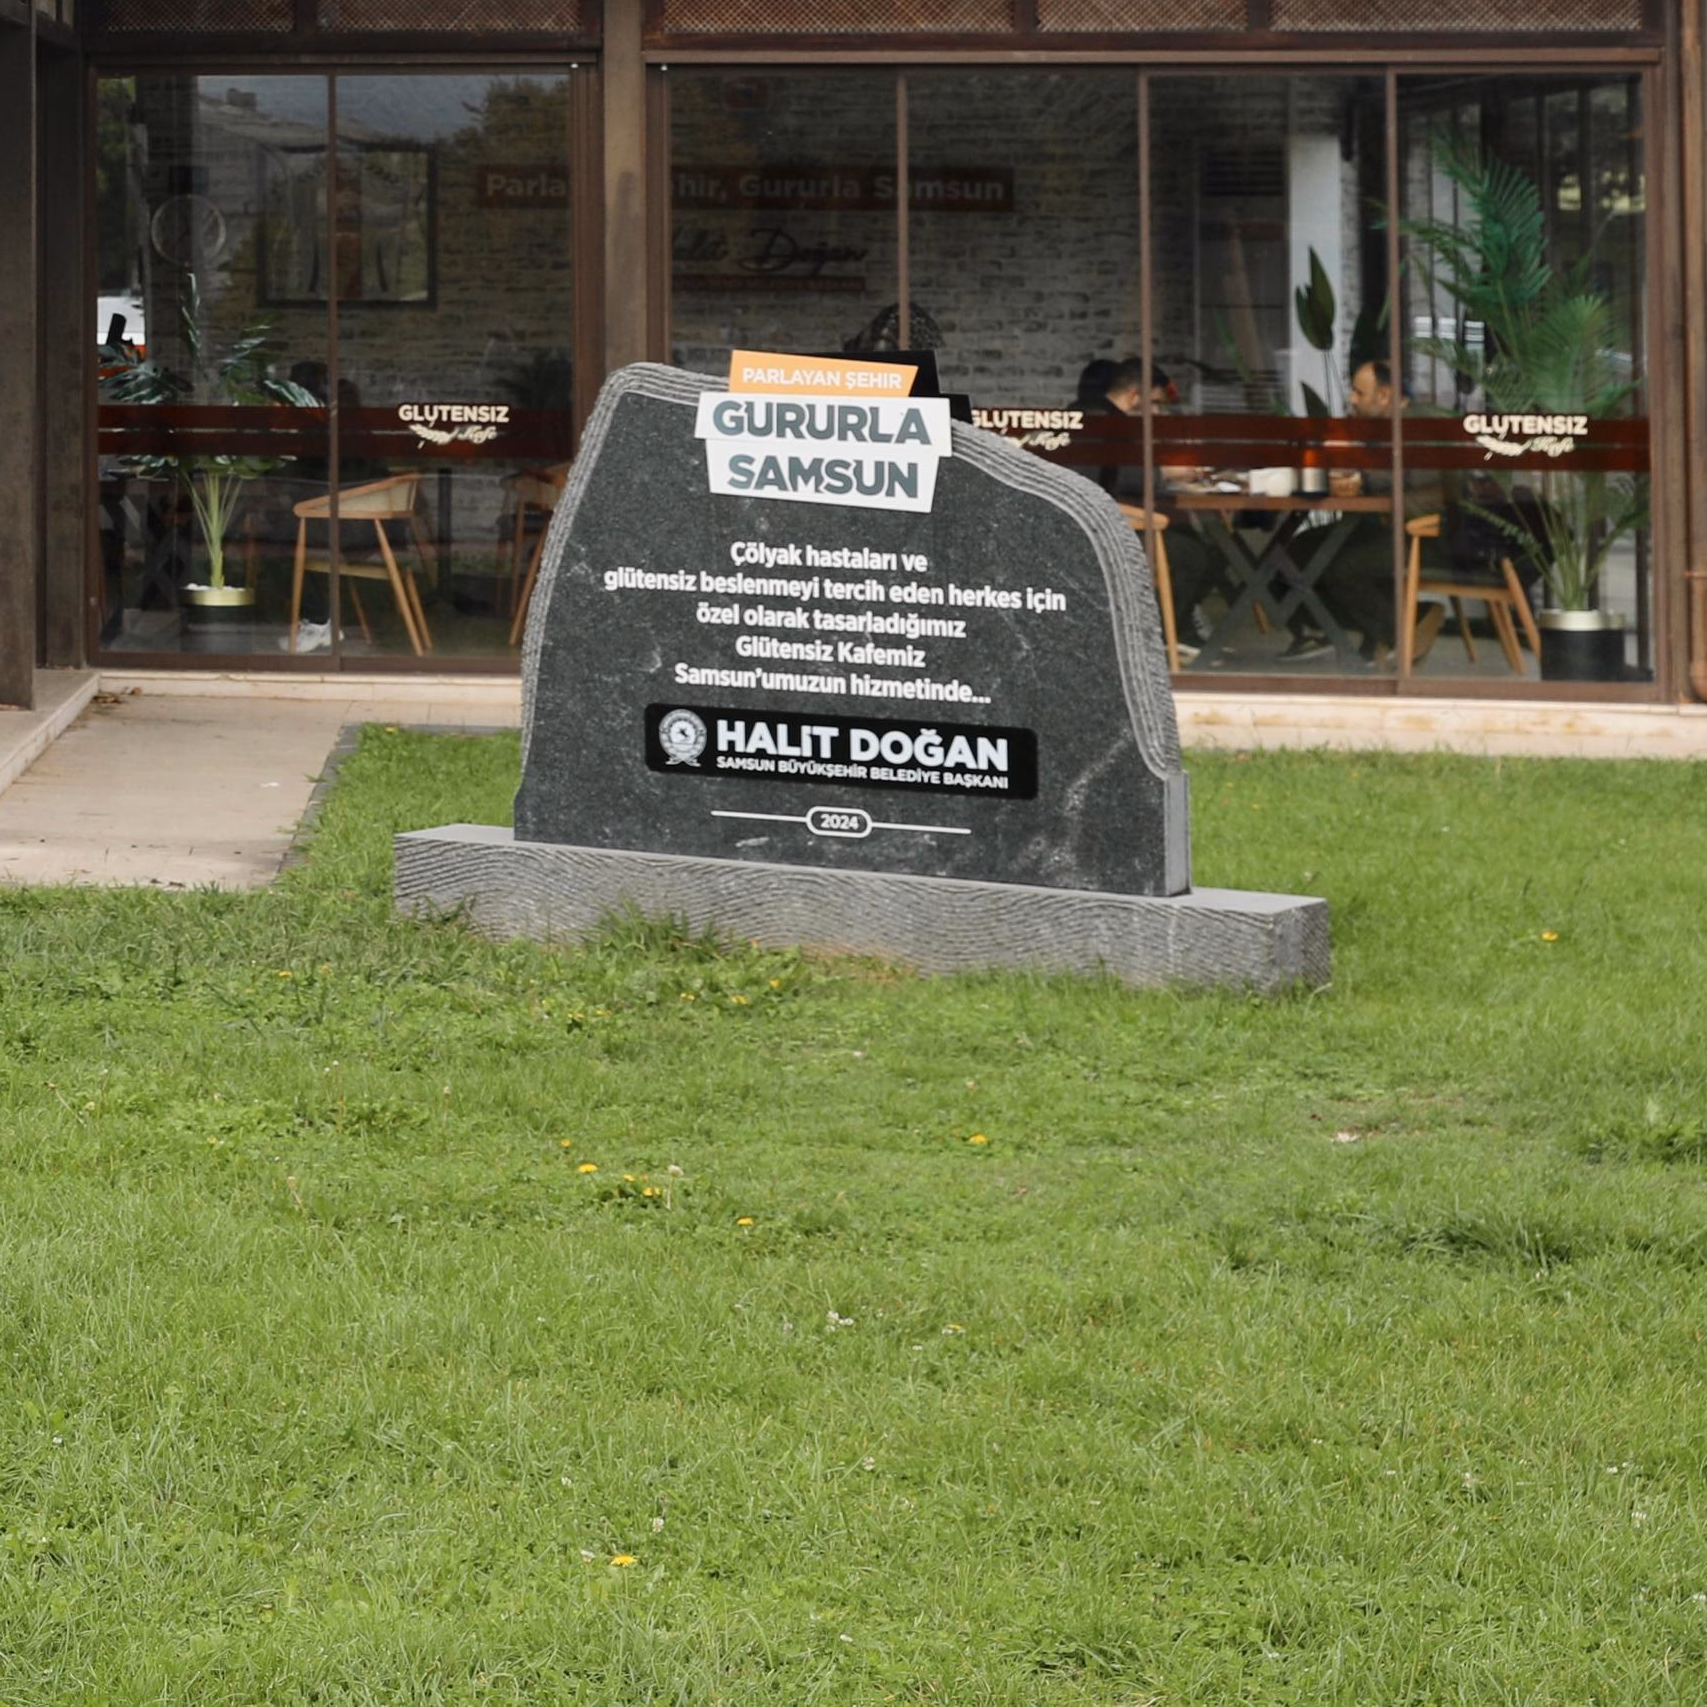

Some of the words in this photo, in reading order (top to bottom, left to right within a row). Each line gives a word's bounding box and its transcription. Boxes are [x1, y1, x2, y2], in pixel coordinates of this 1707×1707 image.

[873, 175, 1005, 200] Smsun
[741, 367, 841, 387] PARLAYAN
[712, 400, 932, 445] GURURLA
[727, 454, 919, 499] SAMSUN
[730, 541, 803, 568] Çölyak
[805, 544, 898, 571] hastaları
[901, 553, 929, 573] ve
[603, 566, 697, 591] glütensiz
[699, 571, 820, 601] beslenmeyi
[823, 578, 886, 602] tercih
[888, 582, 945, 606] eden
[948, 583, 1023, 609] herkes
[1026, 587, 1067, 613] için
[696, 602, 740, 625] özel
[743, 605, 811, 629] olarak
[813, 609, 967, 640] tasarladığımız
[735, 635, 835, 663] Glütensiz
[838, 641, 927, 668] Kafemiz
[849, 673, 992, 704] hizmetinde...
[849, 728, 1009, 772] DOĞAN
[716, 755, 776, 772] SAMSUN
[777, 759, 868, 779] BÜYÜKŞEHİR
[870, 766, 941, 785] BELEDİYE
[943, 771, 1009, 790] BAŞKANI
[820, 813, 860, 830] 2024
